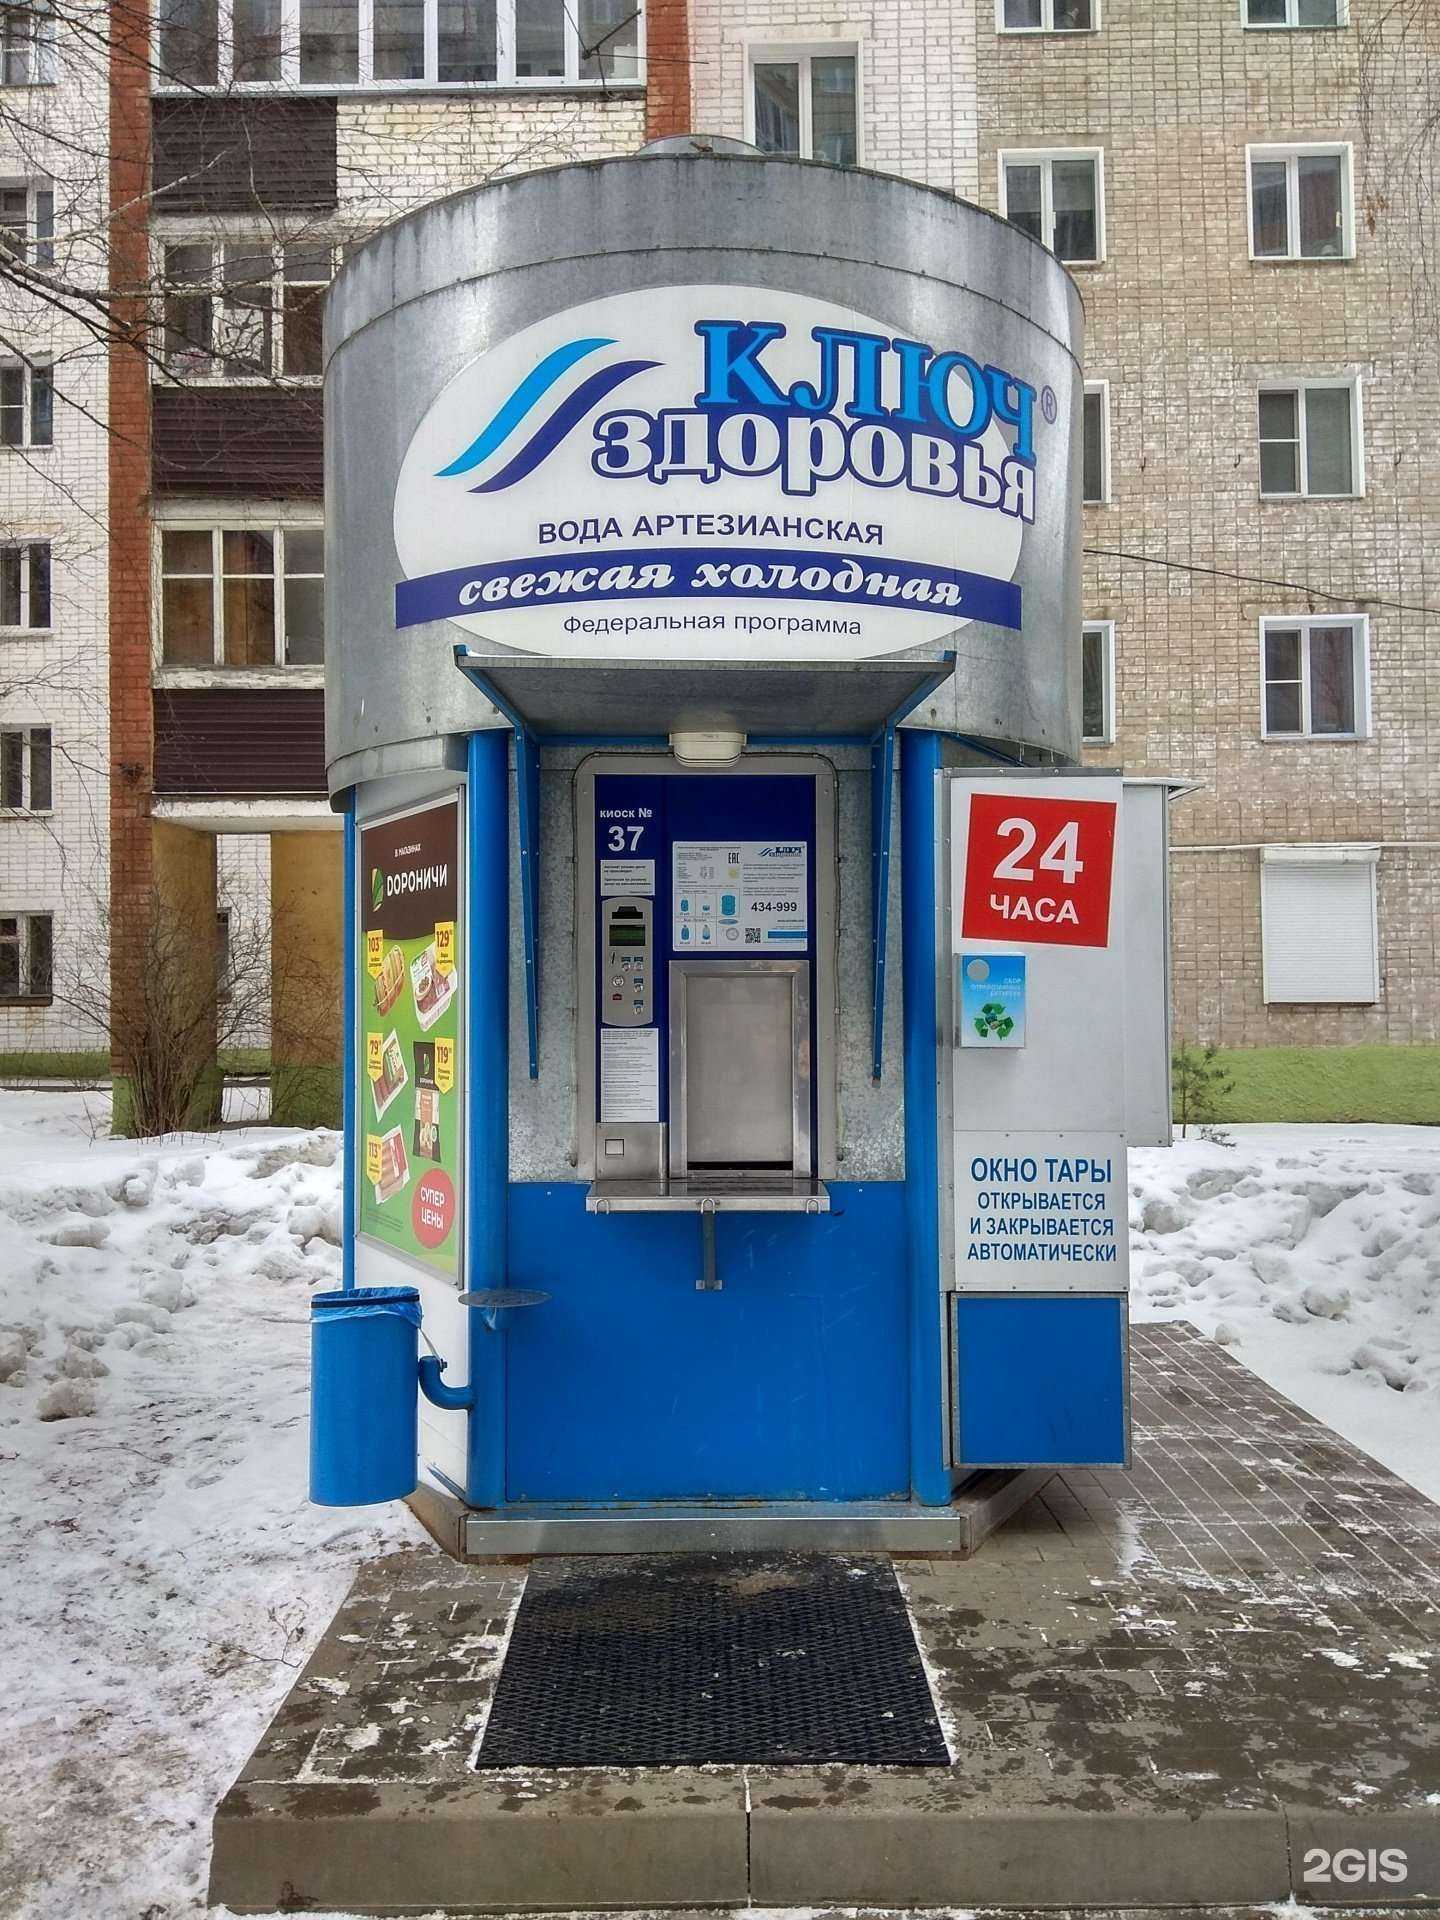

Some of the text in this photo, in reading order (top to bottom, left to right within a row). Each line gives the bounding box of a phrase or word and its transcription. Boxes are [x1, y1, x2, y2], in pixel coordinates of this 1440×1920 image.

[694, 319, 1036, 467] КЛЮЧ
[539, 514, 883, 545] ВОДА АРТЕЗИАНСКАЯ
[458, 558, 962, 607] свежая холодная
[563, 613, 862, 636] Федеральная программа
[600, 810, 635, 818] киоск
[608, 825, 644, 851] 37
[992, 817, 1084, 884] 24
[751, 902, 797, 912] 434-999
[990, 894, 1080, 925] ЧАСА
[970, 1157, 1111, 1183] ОКНО ТАРЫ
[420, 1186, 445, 1207] СУПЕР
[977, 1191, 1106, 1210] ОТКРЫВАЕТСЯ
[421, 1207, 444, 1229] ЦЕНЫ
[970, 1217, 1114, 1236] И ЗАКРЫВАЕТСЯ
[967, 1242, 1117, 1261] АВТОМАТИЧЕСКИ
